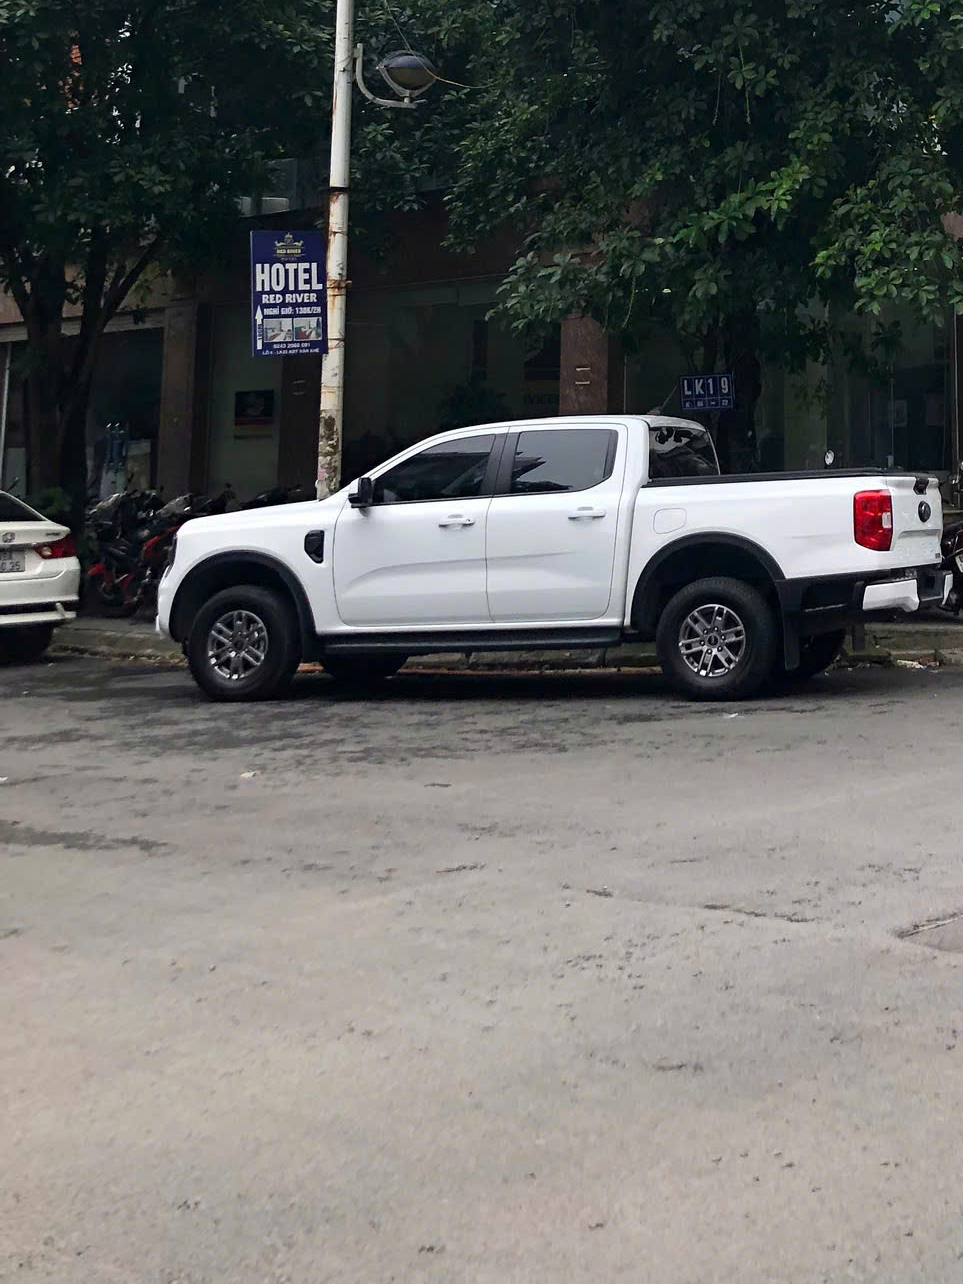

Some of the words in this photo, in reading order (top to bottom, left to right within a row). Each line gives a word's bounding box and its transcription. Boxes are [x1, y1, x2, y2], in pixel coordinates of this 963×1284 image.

[255, 262, 323, 292] HOTEL
[262, 294, 283, 304] RED
[285, 293, 318, 303] RIVER
[683, 377, 729, 395] LK19
